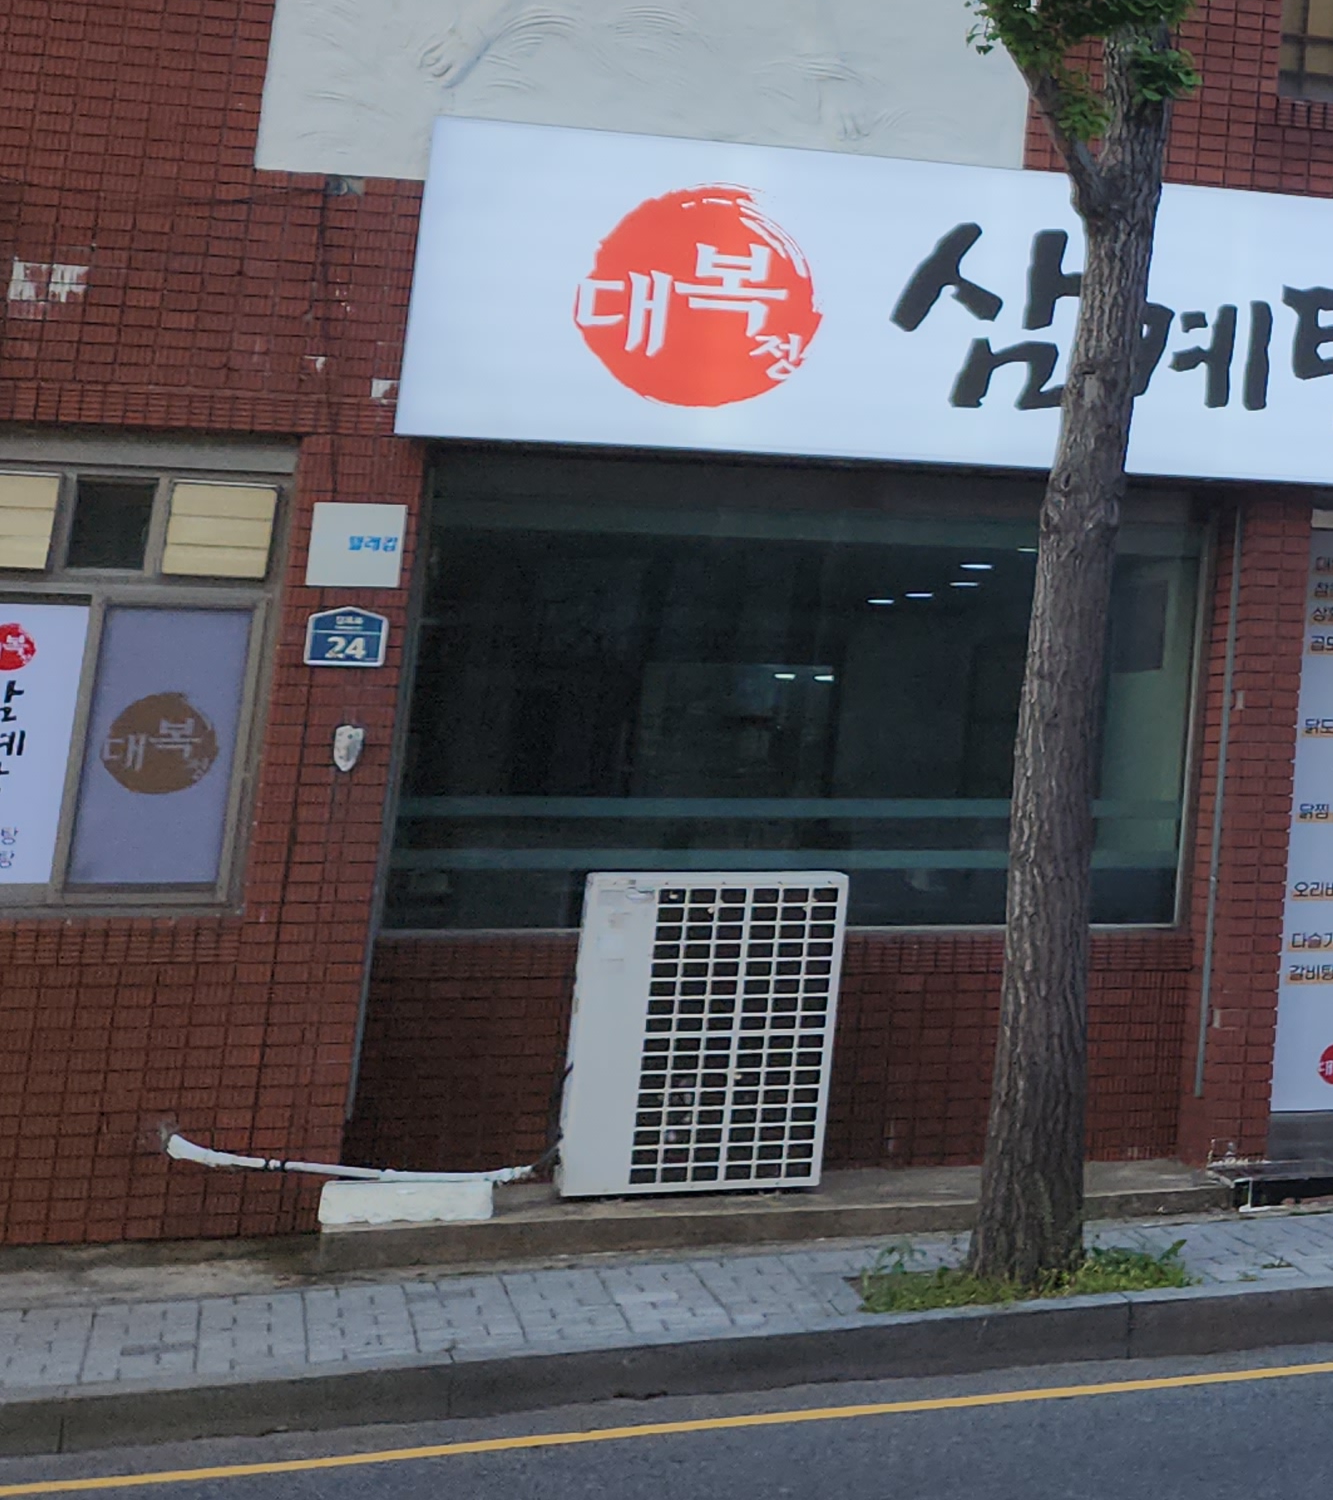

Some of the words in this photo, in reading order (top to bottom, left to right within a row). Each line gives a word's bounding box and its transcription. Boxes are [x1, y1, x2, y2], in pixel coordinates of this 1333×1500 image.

[575, 243, 810, 381] 대복정
[325, 635, 367, 660] 24
[1299, 803, 1329, 820] 닭찜
